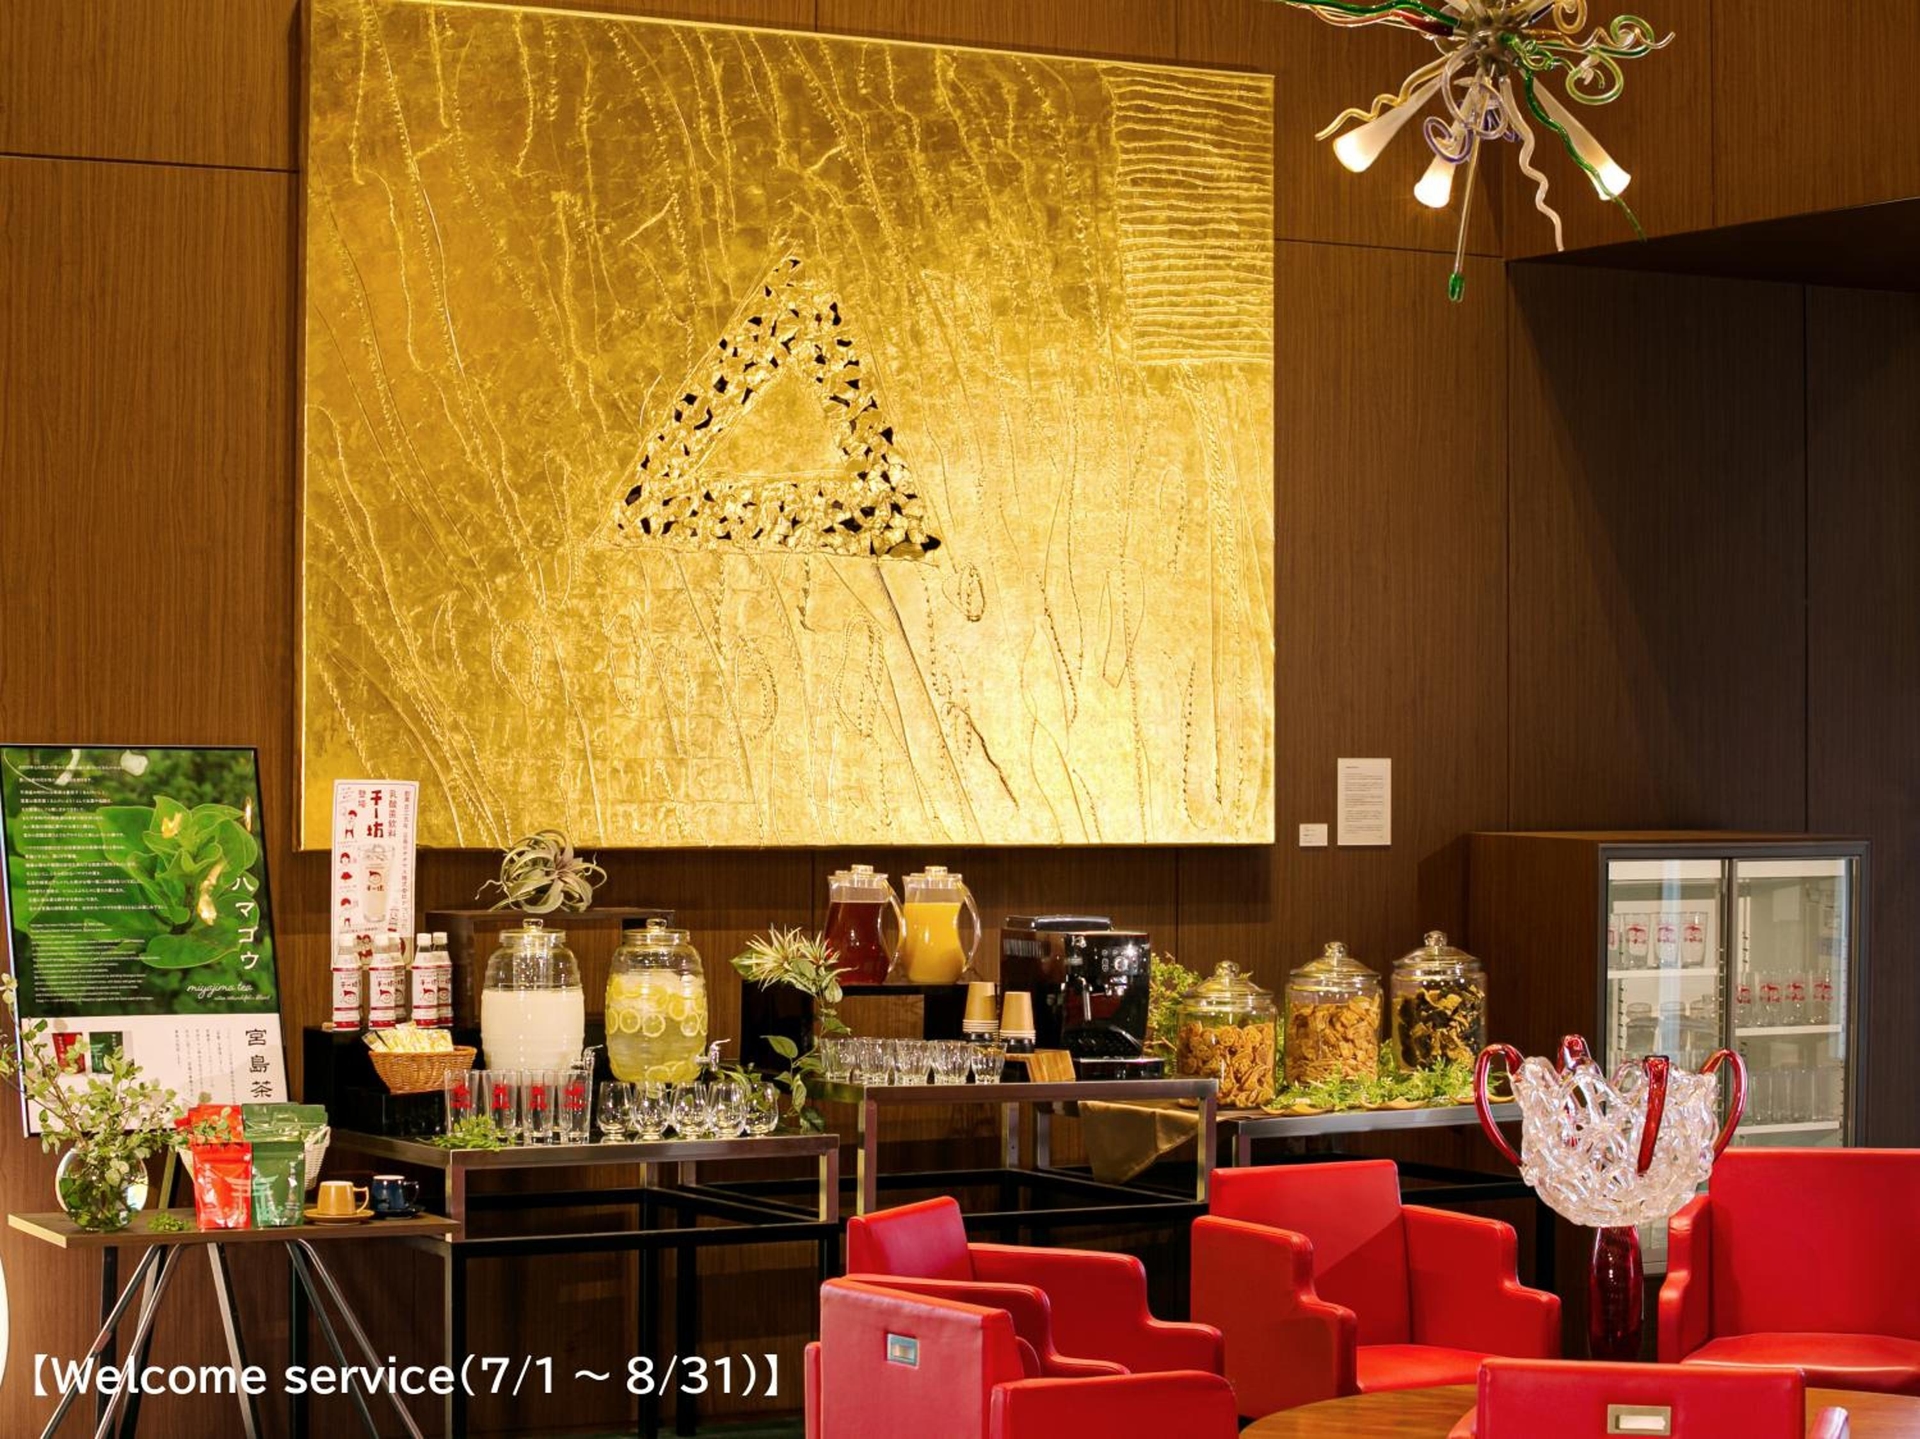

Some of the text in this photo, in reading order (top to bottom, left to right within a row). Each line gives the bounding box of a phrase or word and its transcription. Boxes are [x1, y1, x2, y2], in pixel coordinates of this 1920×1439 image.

[367, 790, 384, 838] チー坊
[231, 877, 259, 970] ハマゴウ
[186, 982, 236, 1000] miyajima
[237, 981, 253, 992] tea
[245, 1028, 273, 1099] 宮島茶
